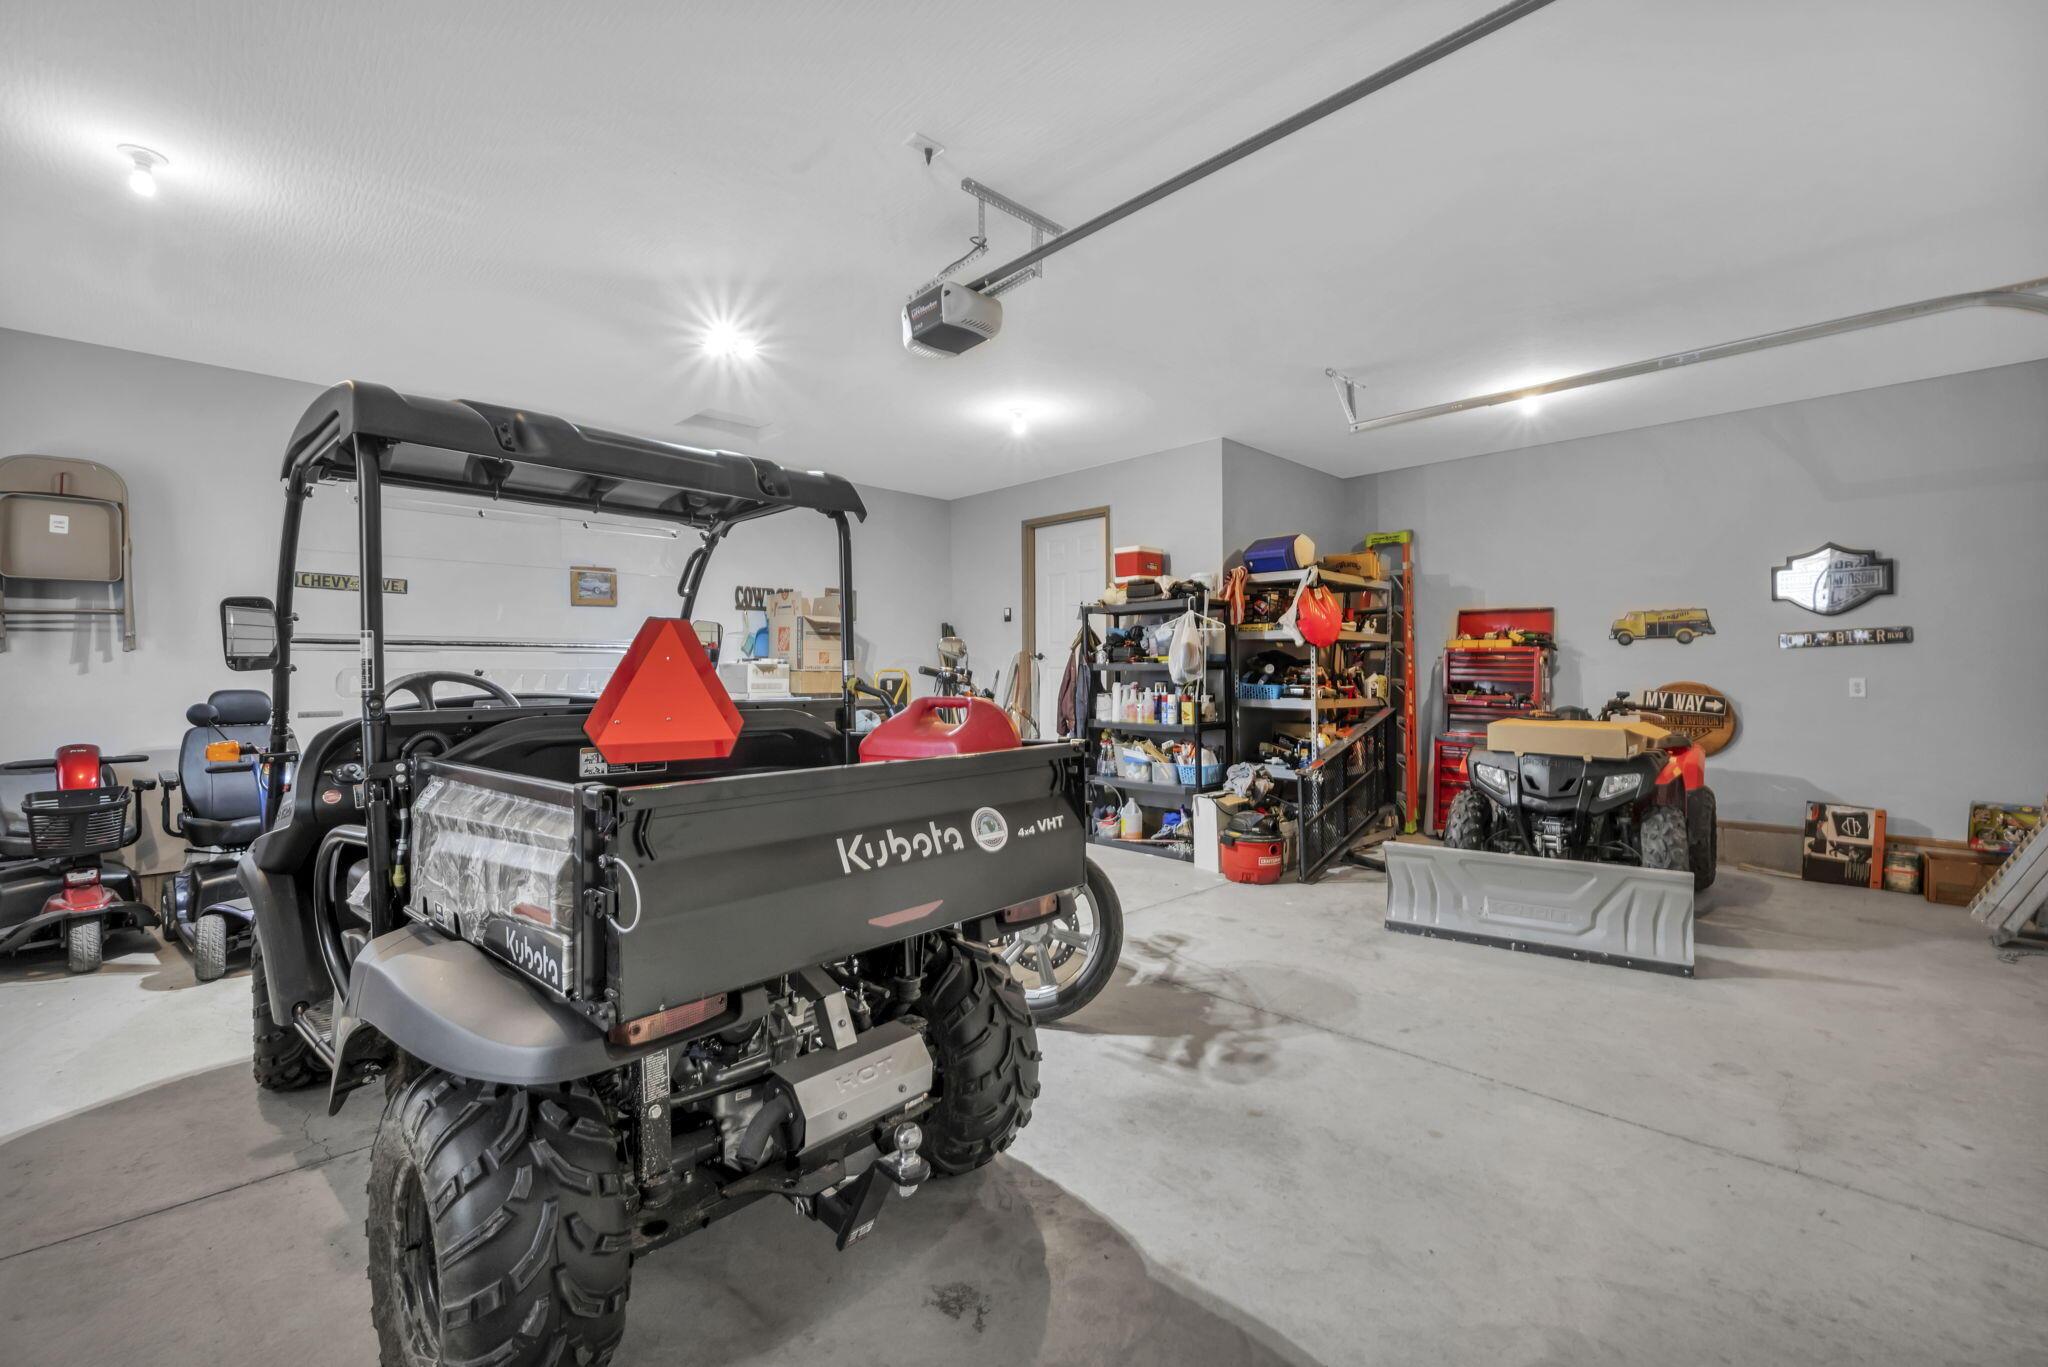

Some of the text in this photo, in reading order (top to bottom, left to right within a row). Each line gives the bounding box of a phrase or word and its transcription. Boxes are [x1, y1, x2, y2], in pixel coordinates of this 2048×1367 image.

[301, 573, 351, 589] CHEVY
[735, 586, 794, 608] COW
[1645, 691, 1705, 713] MY WAY
[836, 821, 964, 874] Kubota
[1017, 824, 1036, 838] 4x4
[1036, 815, 1064, 833] VHT
[505, 926, 558, 985] Kubota
[835, 1056, 893, 1094] HOT
